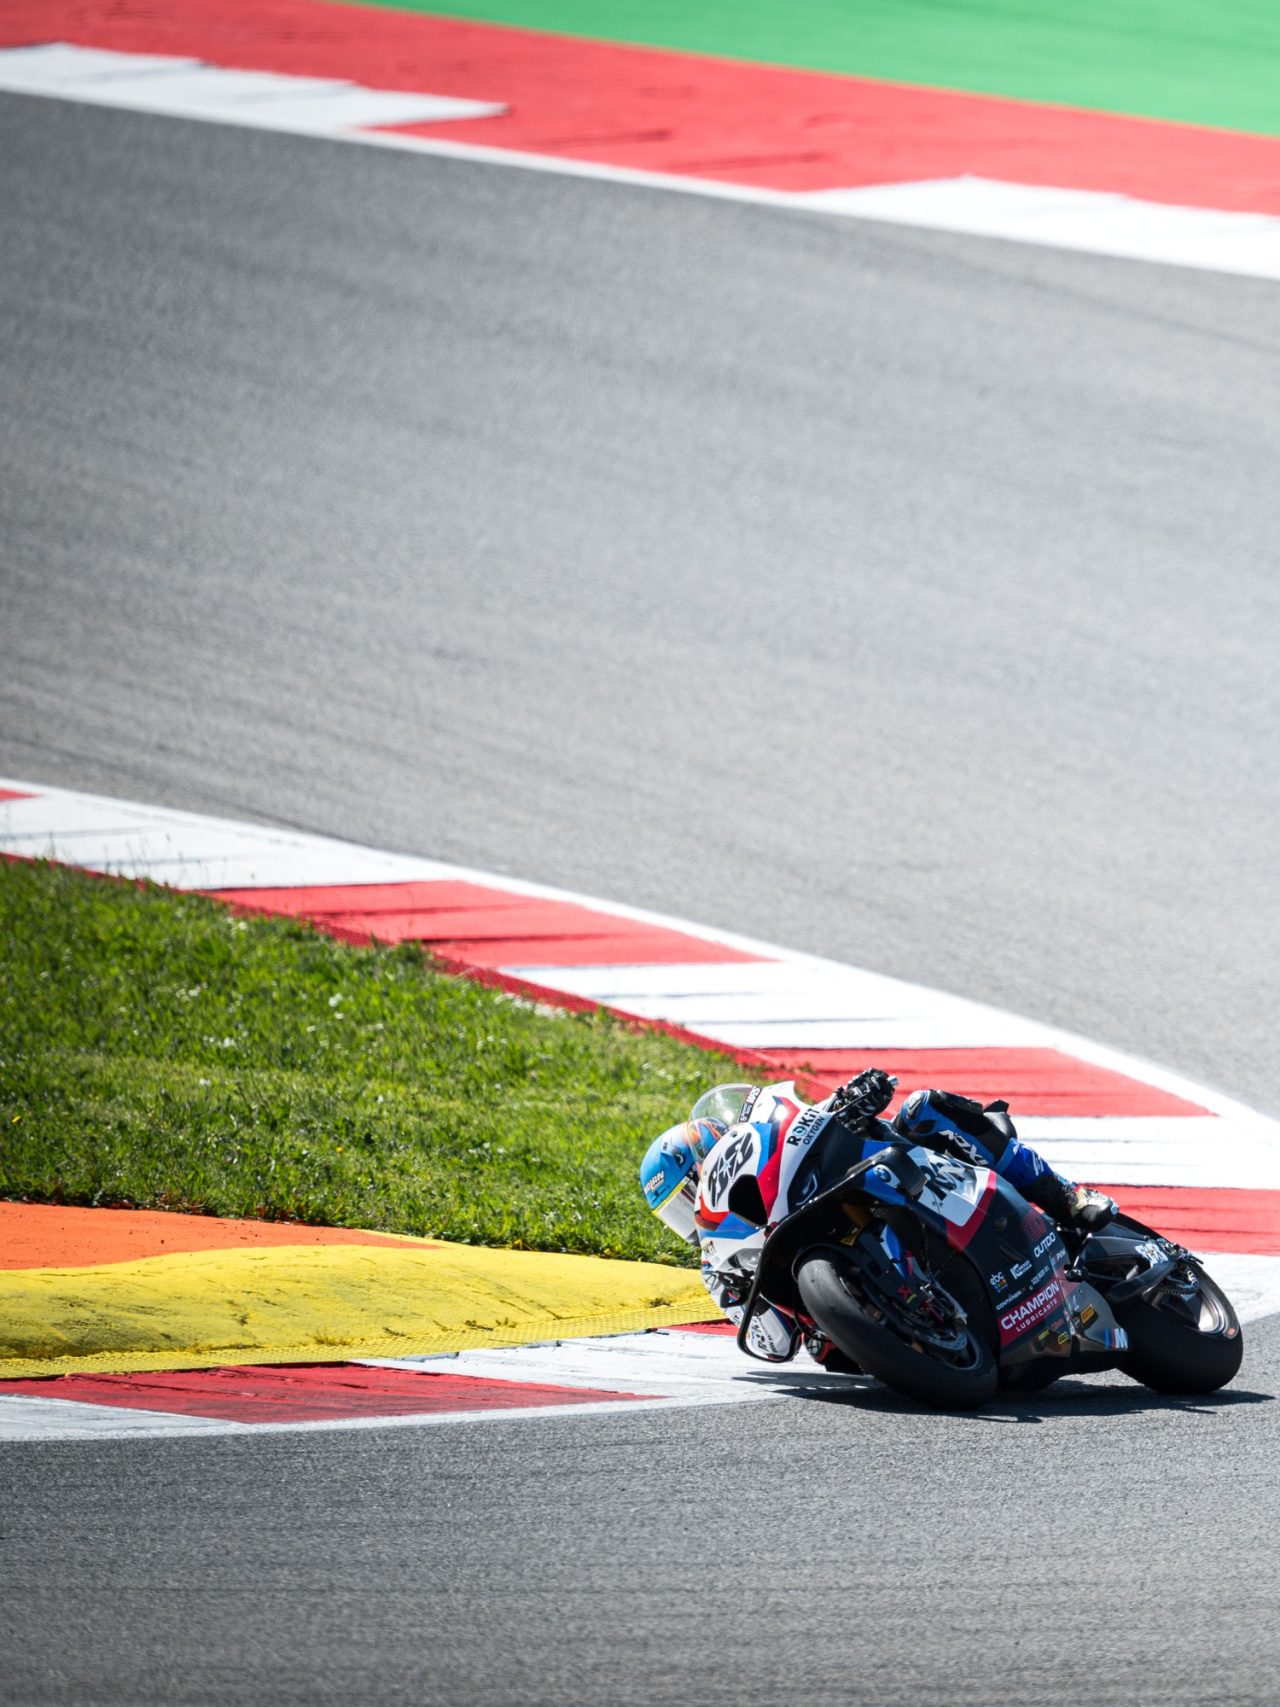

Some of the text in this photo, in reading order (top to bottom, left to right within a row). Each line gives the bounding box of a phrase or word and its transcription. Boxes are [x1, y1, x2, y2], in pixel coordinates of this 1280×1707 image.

[803, 1116, 825, 1145] OXYGEN
[1034, 1232, 1056, 1258] OUTDO
[990, 1272, 1004, 1285] ebc
[1001, 1281, 1060, 1330] CHAMPION
[1016, 1298, 1058, 1332] LUBRICANTS
